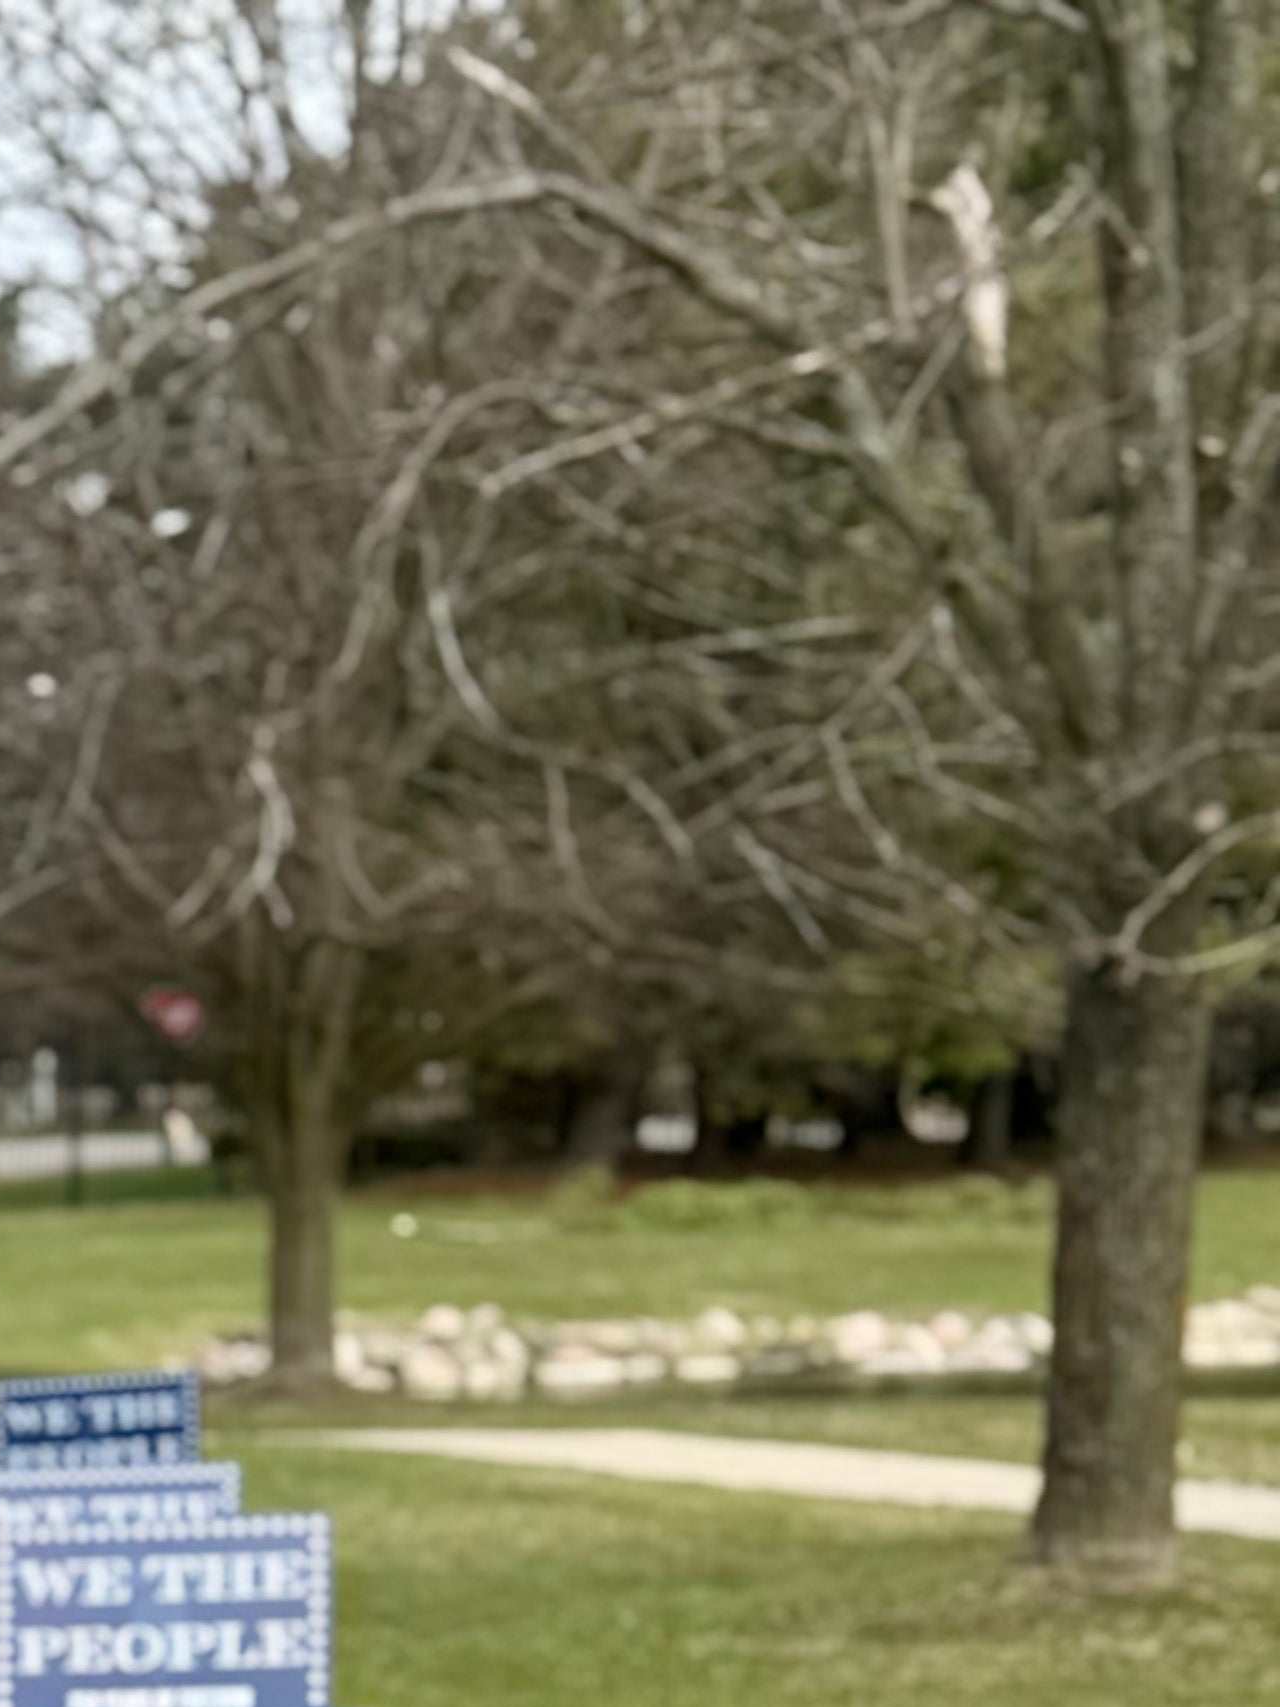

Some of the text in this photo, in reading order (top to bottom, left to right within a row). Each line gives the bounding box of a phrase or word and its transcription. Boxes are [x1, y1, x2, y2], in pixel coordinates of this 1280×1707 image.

[16, 1549, 309, 1608] WE THE
[15, 1617, 309, 1676] PEOPLE
